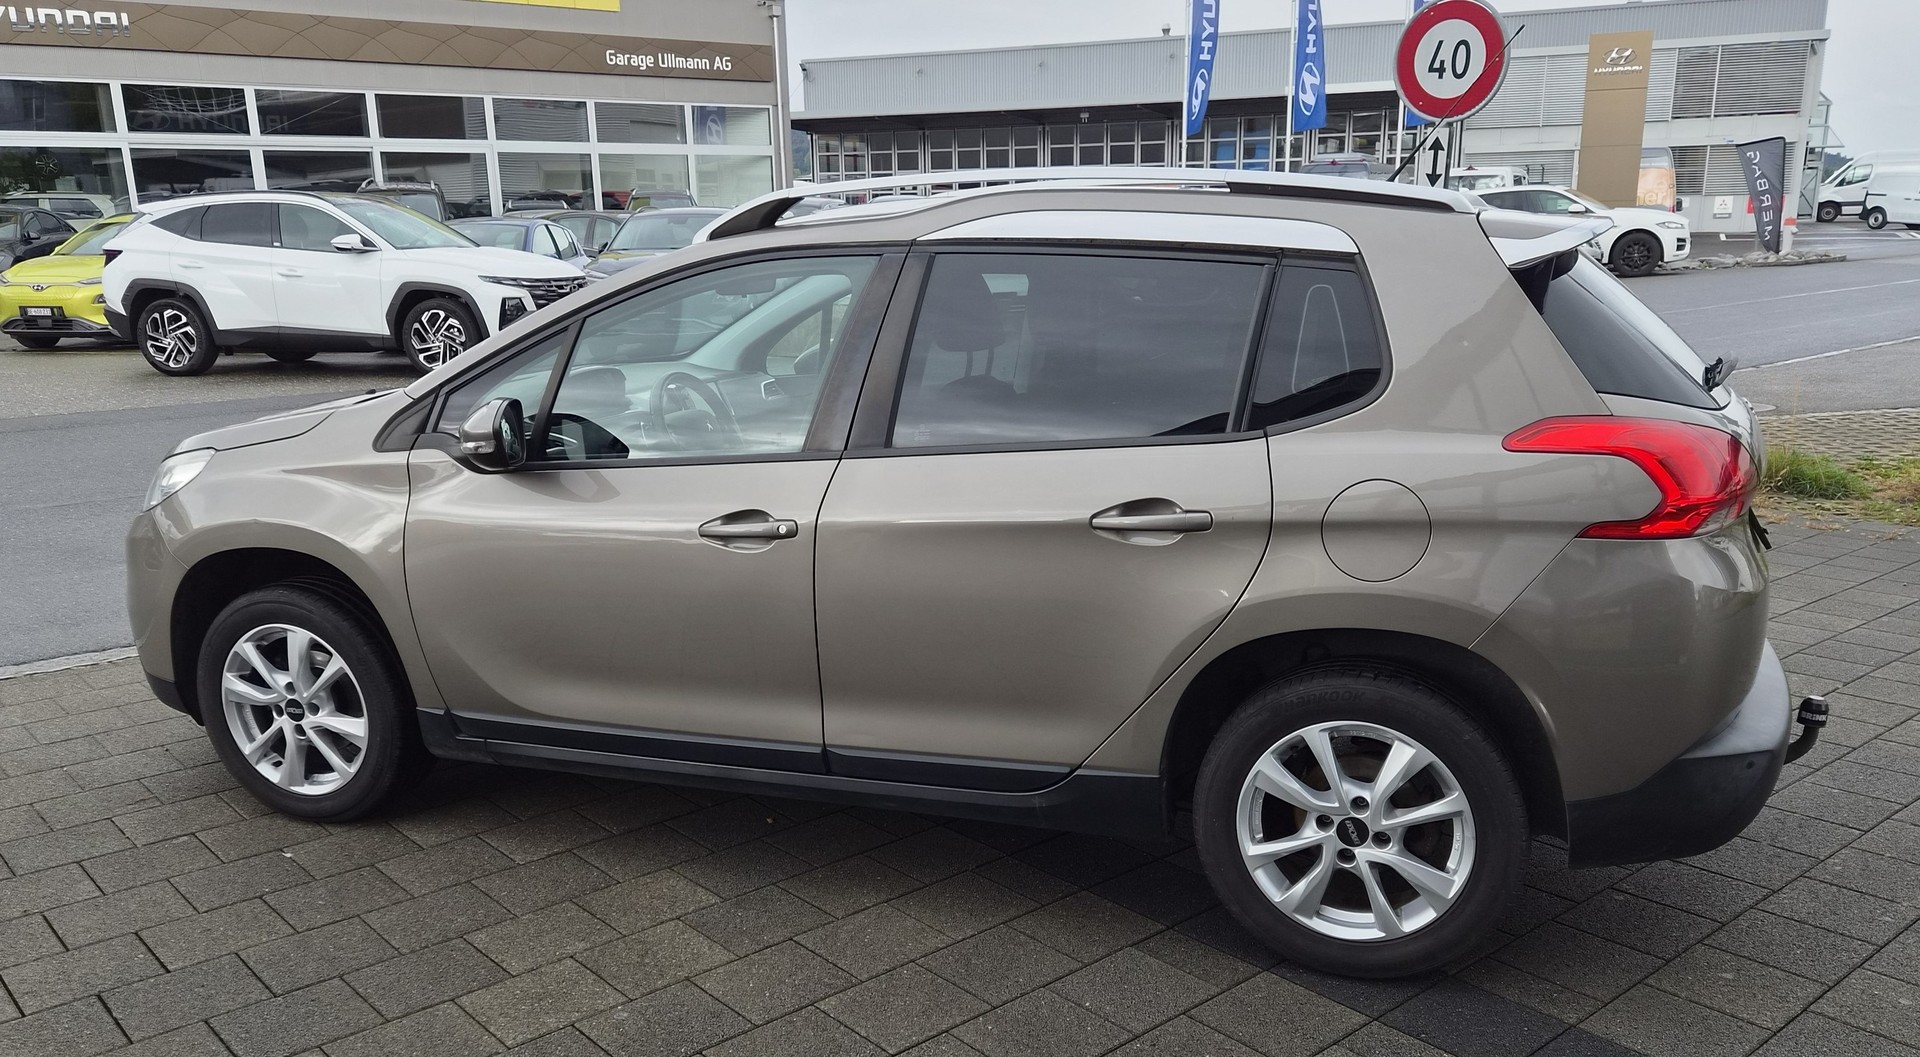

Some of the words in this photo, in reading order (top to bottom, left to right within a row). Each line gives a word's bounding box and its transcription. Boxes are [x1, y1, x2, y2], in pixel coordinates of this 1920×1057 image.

[0, 5, 131, 37] UNDAI
[605, 49, 654, 70] Garage
[658, 52, 710, 70] Ullmann
[713, 56, 732, 71] AG
[1427, 39, 1472, 79] 40
[1593, 65, 1643, 76] HYUNDAI
[178, 112, 289, 132] HYUNAI
